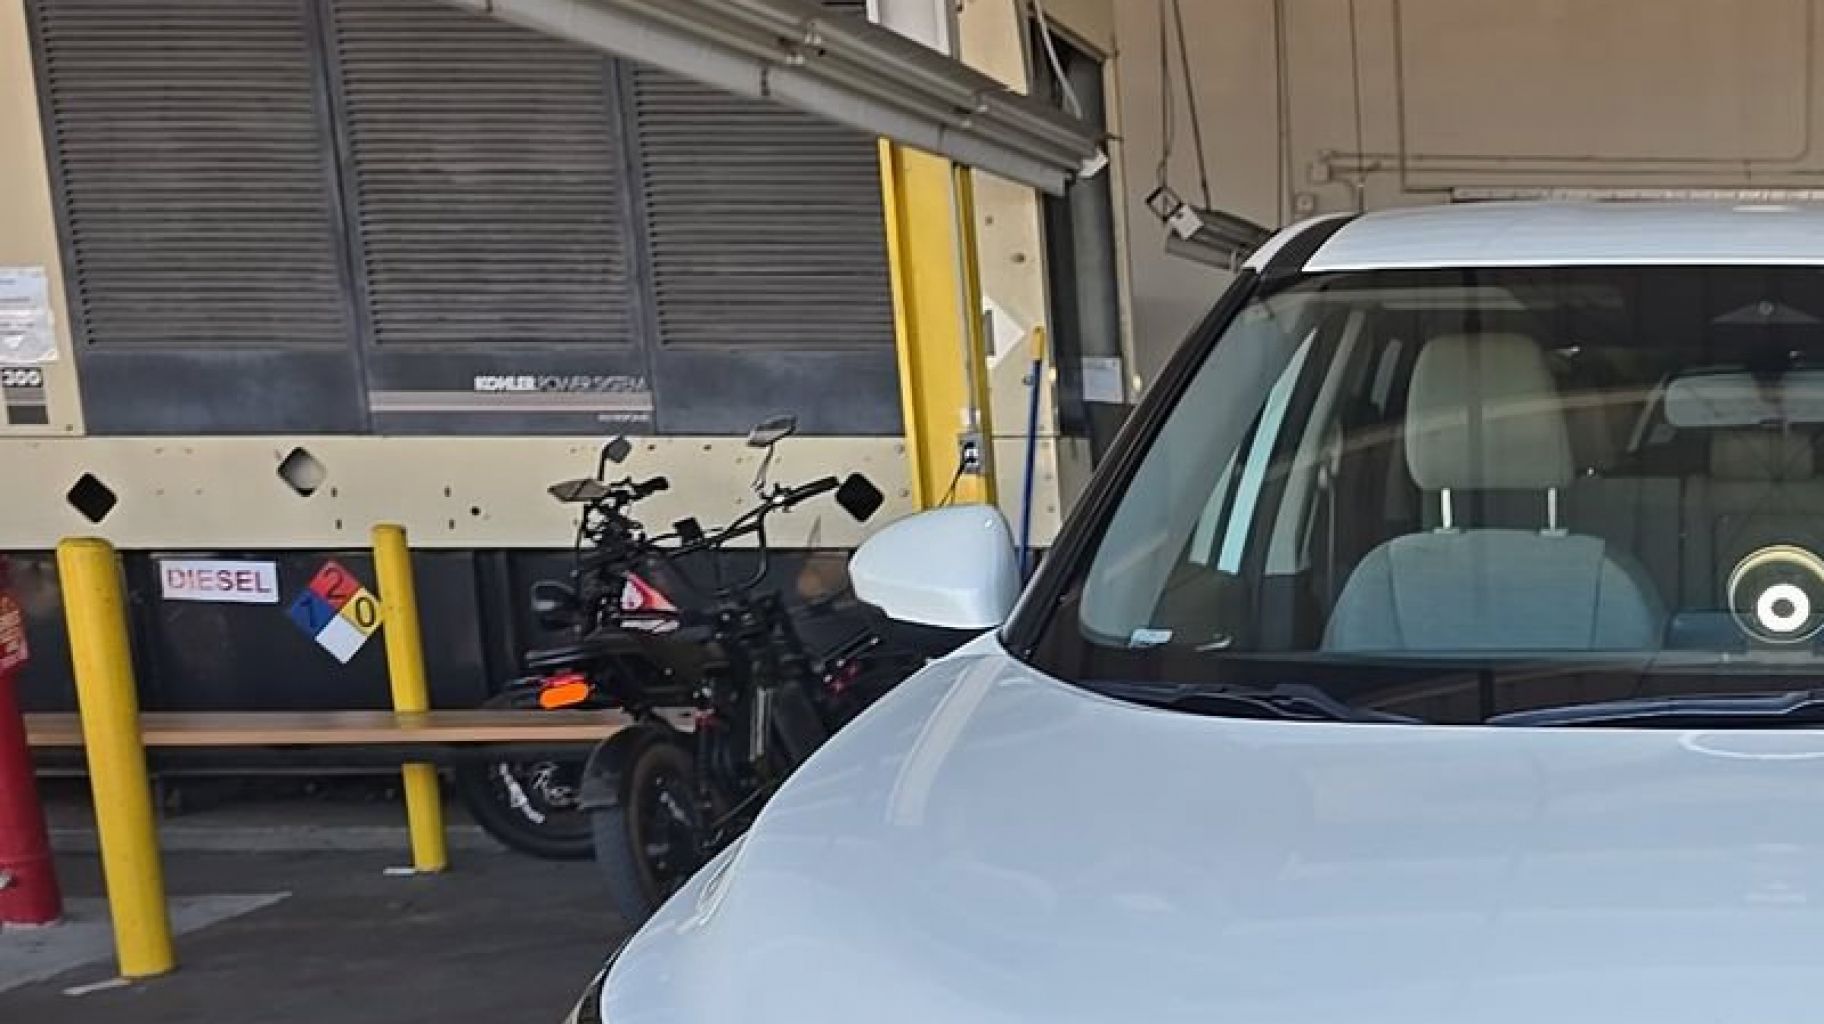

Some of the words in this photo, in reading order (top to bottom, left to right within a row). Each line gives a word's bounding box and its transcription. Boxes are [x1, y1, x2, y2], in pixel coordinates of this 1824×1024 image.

[166, 569, 272, 593] DIESEL
[323, 567, 345, 599] 2
[355, 596, 376, 628] 0
